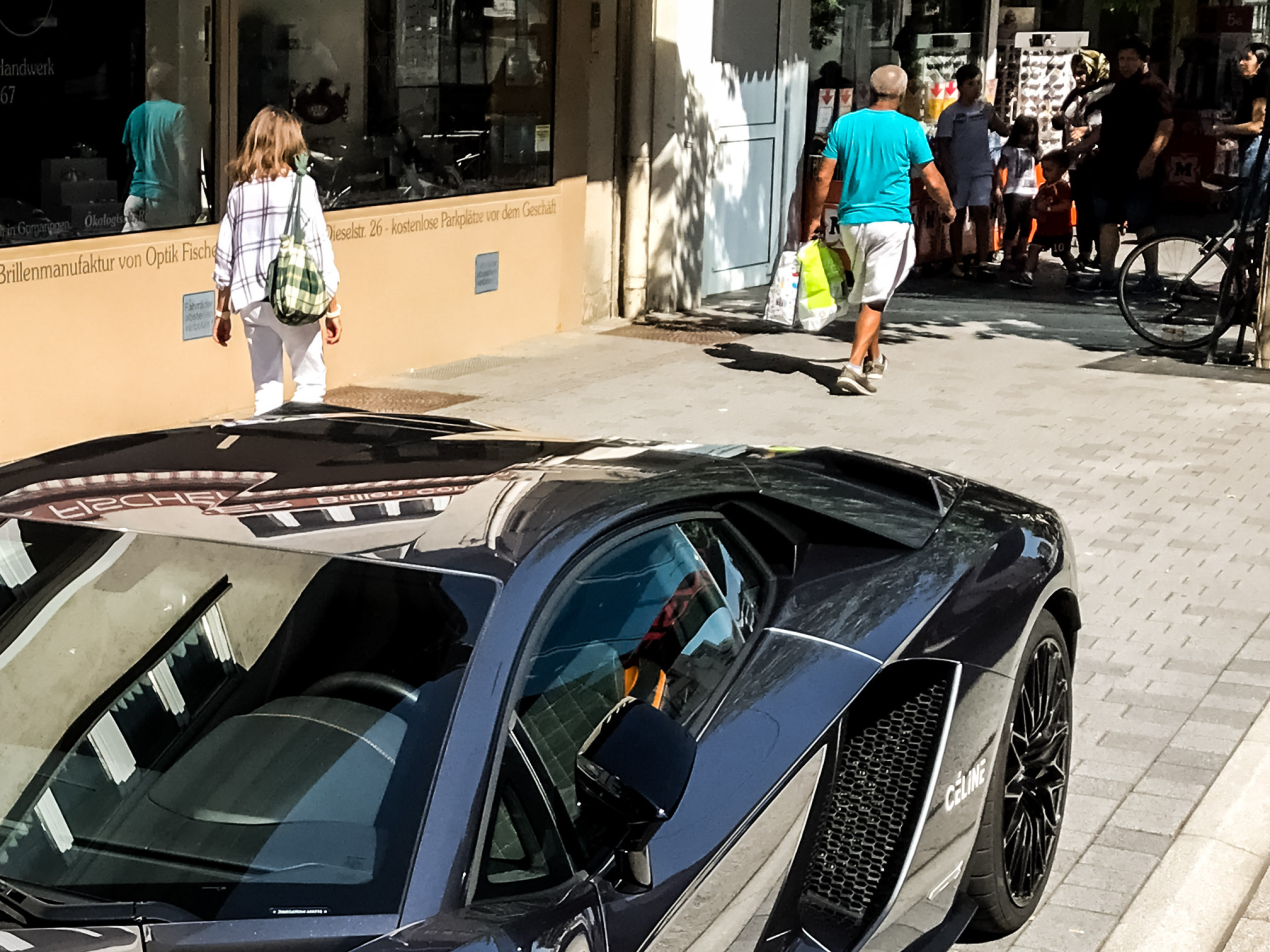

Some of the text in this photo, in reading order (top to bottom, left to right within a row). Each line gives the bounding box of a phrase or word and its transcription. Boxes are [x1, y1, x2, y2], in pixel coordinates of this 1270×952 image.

[326, 221, 367, 243] Dieselstr.
[369, 218, 383, 237] 26
[391, 215, 438, 235] kostenlose
[441, 209, 484, 230] Parkplätze
[486, 209, 500, 222] vor
[501, 203, 521, 221] dem
[522, 200, 557, 218] Geschäft
[119, 252, 142, 270] von
[146, 243, 179, 269] Optik
[182, 240, 216, 261] Fische
[1052, 242, 1066, 253] 10
